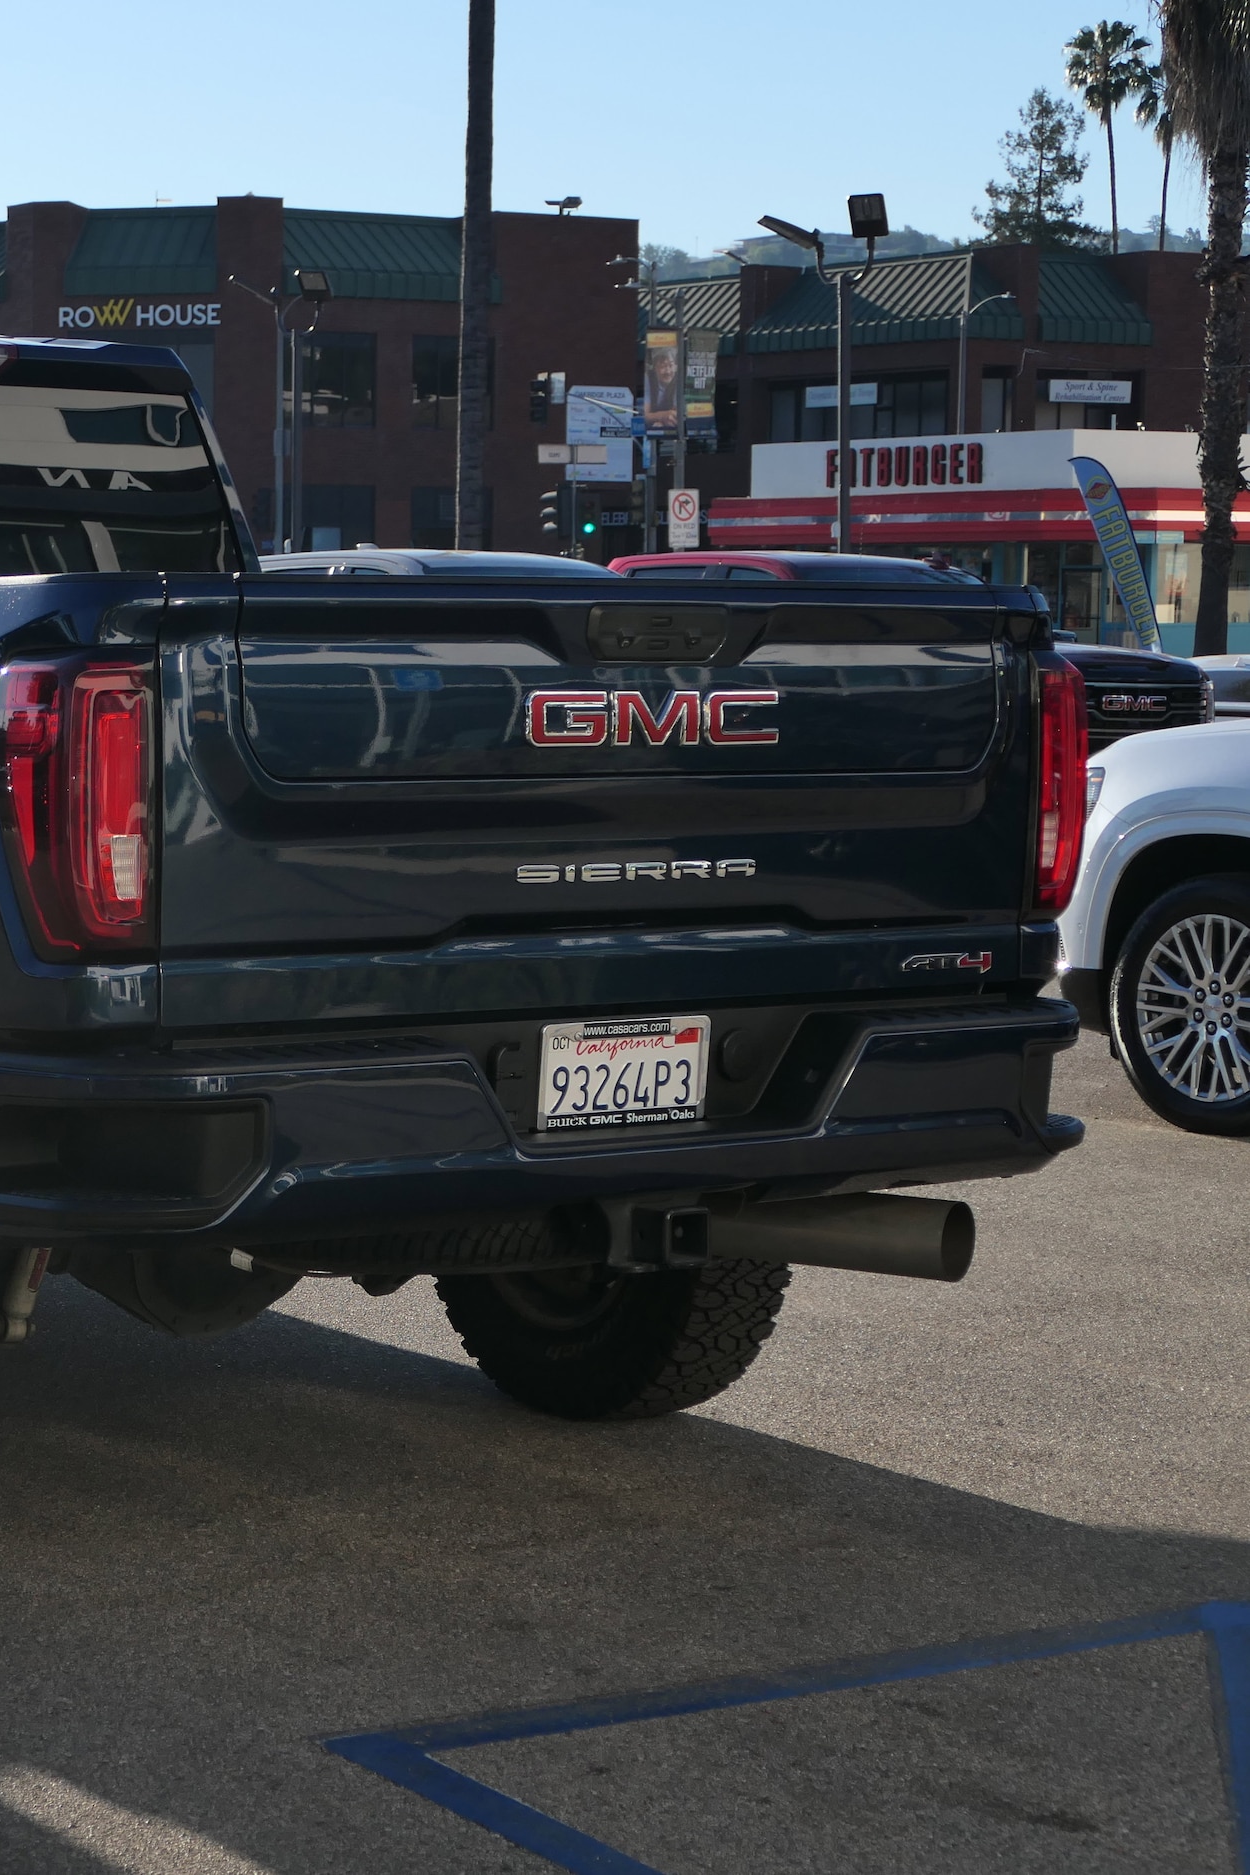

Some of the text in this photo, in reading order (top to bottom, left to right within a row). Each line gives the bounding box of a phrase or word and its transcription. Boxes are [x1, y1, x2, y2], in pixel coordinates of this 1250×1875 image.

[136, 304, 221, 326] HOUSE
[687, 366, 715, 378] NETFLIX
[694, 378, 706, 389] HIT
[1065, 382, 1118, 393] Sport & Spine
[1055, 392, 1126, 402] Rehabilitation Center
[1093, 505, 1158, 646] FATBURGER
[1102, 695, 1167, 711] GMC
[525, 690, 779, 747] GMC
[516, 858, 756, 884] SIERRA
[902, 952, 992, 974] AT4
[584, 1021, 670, 1037] www.casacars.com
[552, 1036, 675, 1060] OCT California
[550, 1059, 692, 1114] 93264P3
[547, 1109, 695, 1128] BUICK GMC Sherman Oaks
